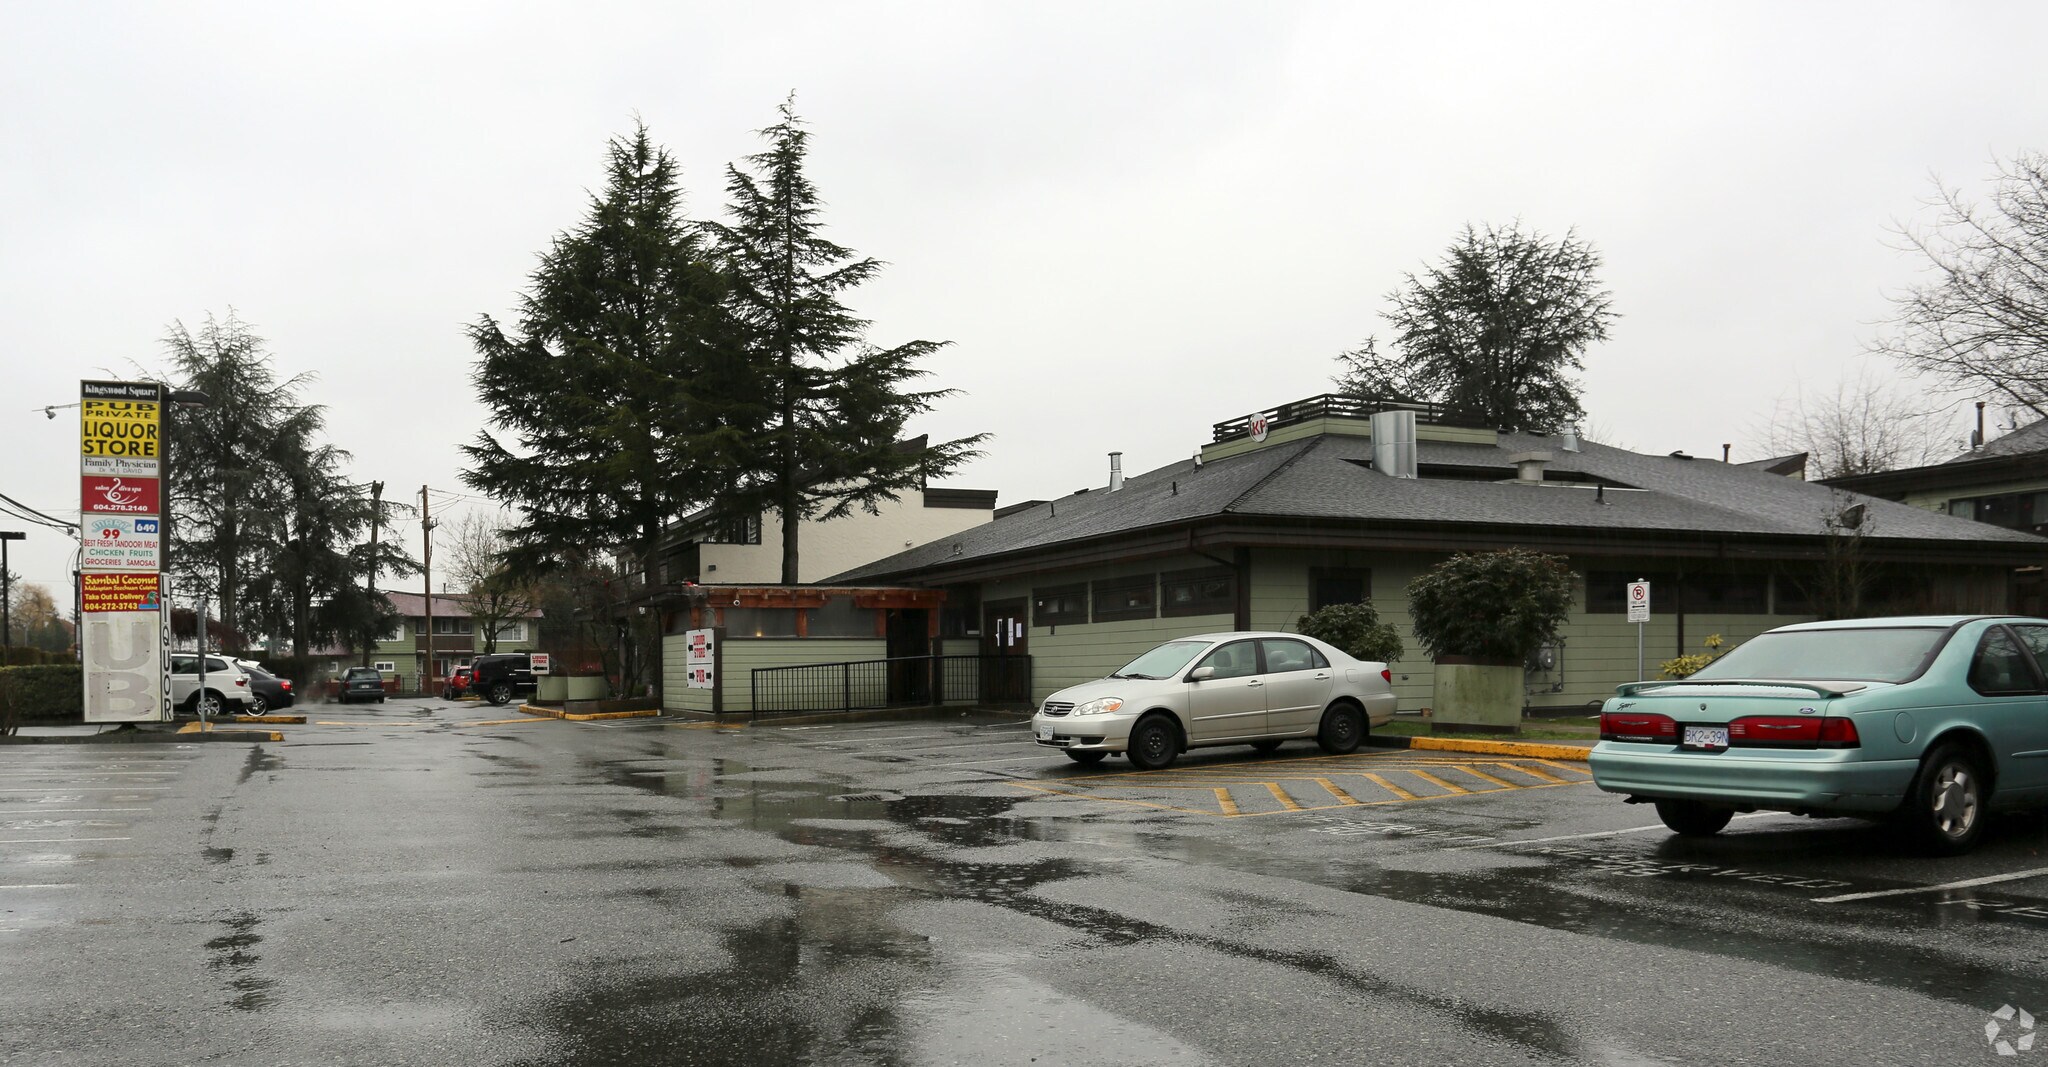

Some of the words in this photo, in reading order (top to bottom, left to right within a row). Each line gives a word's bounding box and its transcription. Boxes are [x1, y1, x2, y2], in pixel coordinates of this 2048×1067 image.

[85, 384, 127, 395] Kingswood
[128, 386, 156, 397] Square
[85, 401, 156, 411] PUB
[86, 410, 151, 418] PRIVATE
[84, 421, 157, 439] LIQUOR
[83, 439, 154, 456] STORE
[85, 458, 113, 468] Family
[116, 459, 156, 469] Physician
[136, 524, 156, 532] 649
[103, 529, 121, 539] 99
[84, 539, 96, 547] BEST
[114, 540, 143, 548] TANDOORI
[144, 541, 158, 549] MEAT
[89, 548, 125, 556] CHICKEN
[129, 549, 153, 557] FRUITS
[85, 558, 121, 566] GROCERIES
[126, 559, 156, 567] SAMOSAS
[85, 575, 119, 585] Sambal
[121, 575, 158, 585] Coconut
[119, 593, 145, 601] Delivery
[84, 602, 138, 610] 604-272-3743
[693, 635, 705, 646] LIQUOR
[162, 575, 172, 720] LIQUOR
[694, 647, 705, 658] STORE
[696, 669, 705, 683] PUB
